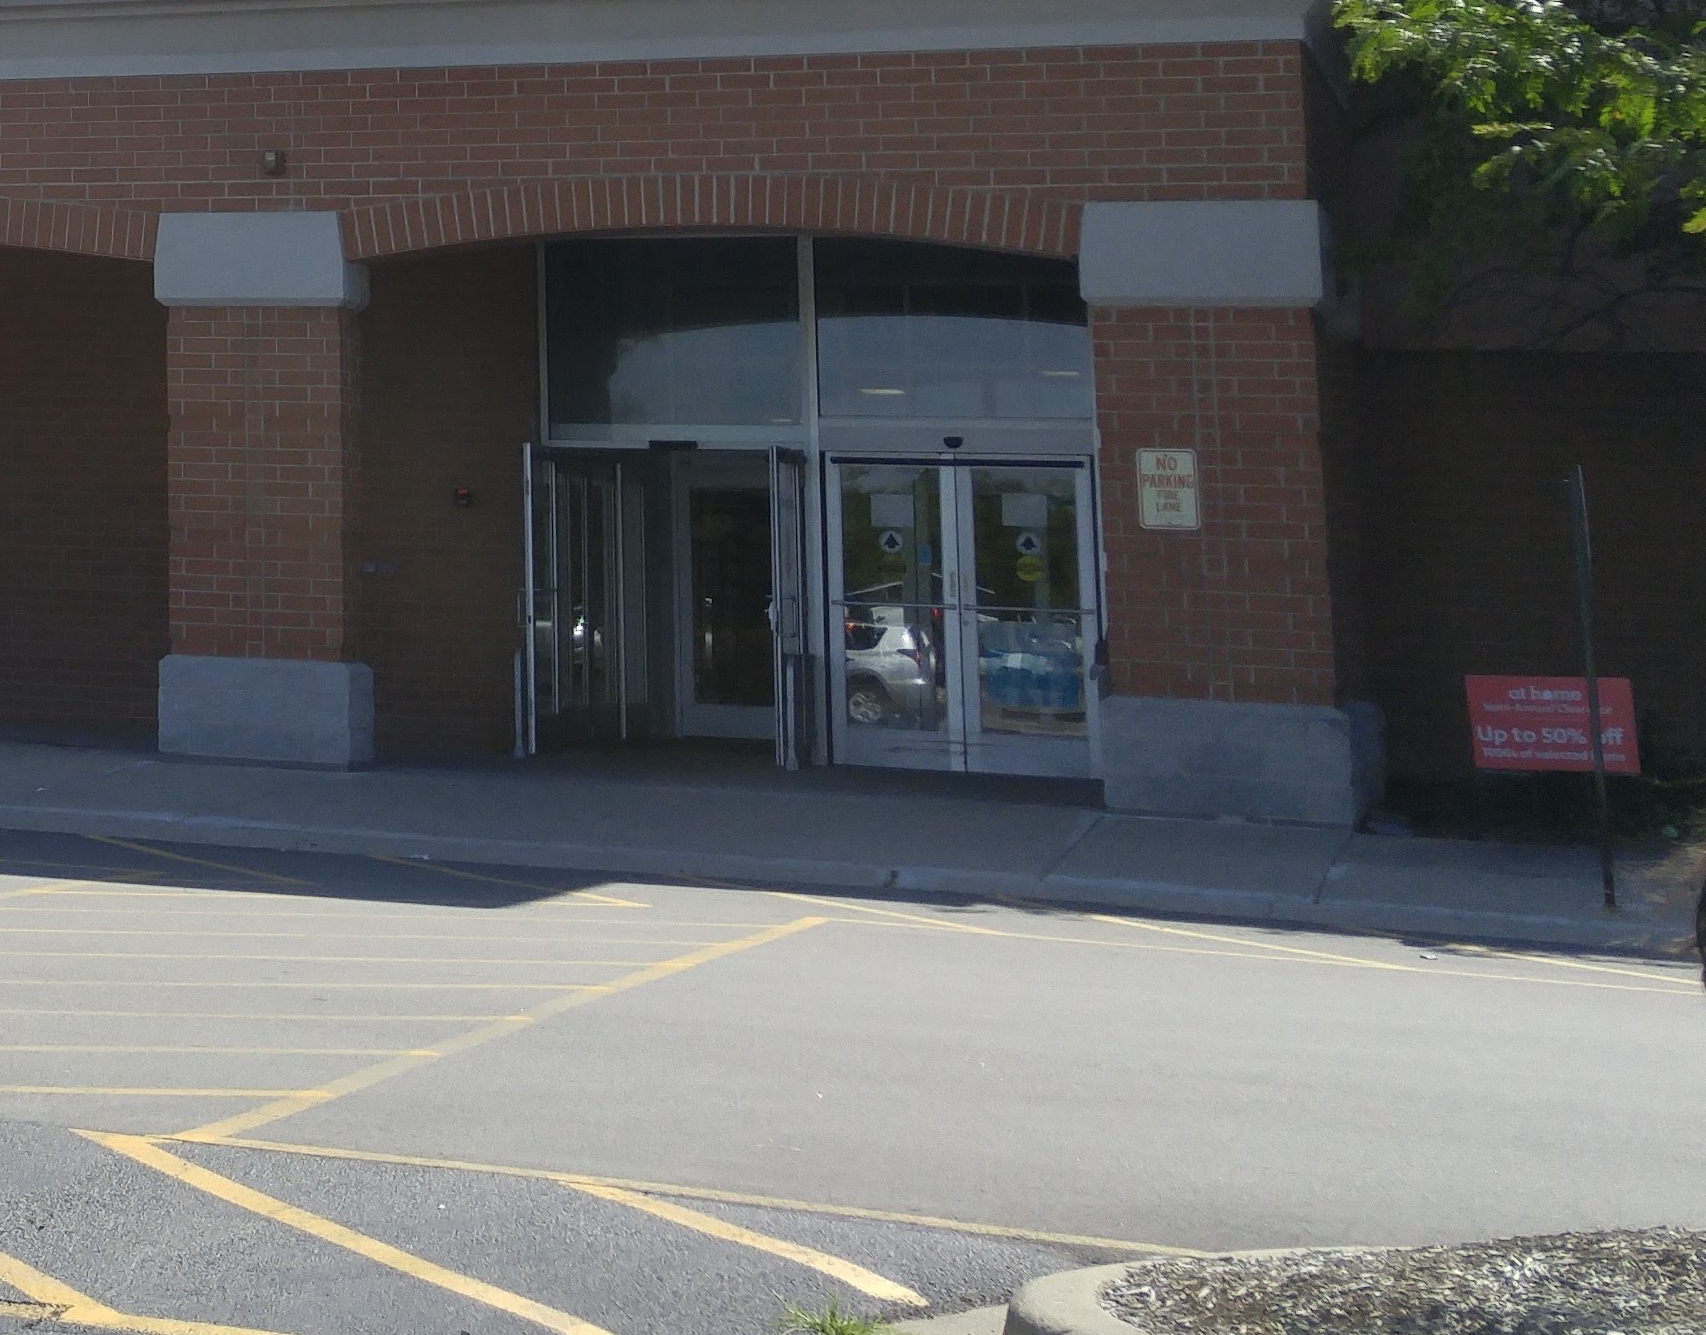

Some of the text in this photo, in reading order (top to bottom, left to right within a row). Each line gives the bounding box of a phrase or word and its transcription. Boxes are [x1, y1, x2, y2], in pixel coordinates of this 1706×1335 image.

[1155, 456, 1178, 471] NO
[1140, 473, 1195, 489] PARKING
[1156, 490, 1181, 501] FIRE
[1156, 501, 1183, 513] LANE
[1508, 687, 1527, 700] at
[1476, 725, 1508, 746] Up
[1511, 726, 1537, 743] to
[1541, 726, 1588, 745] 50%
